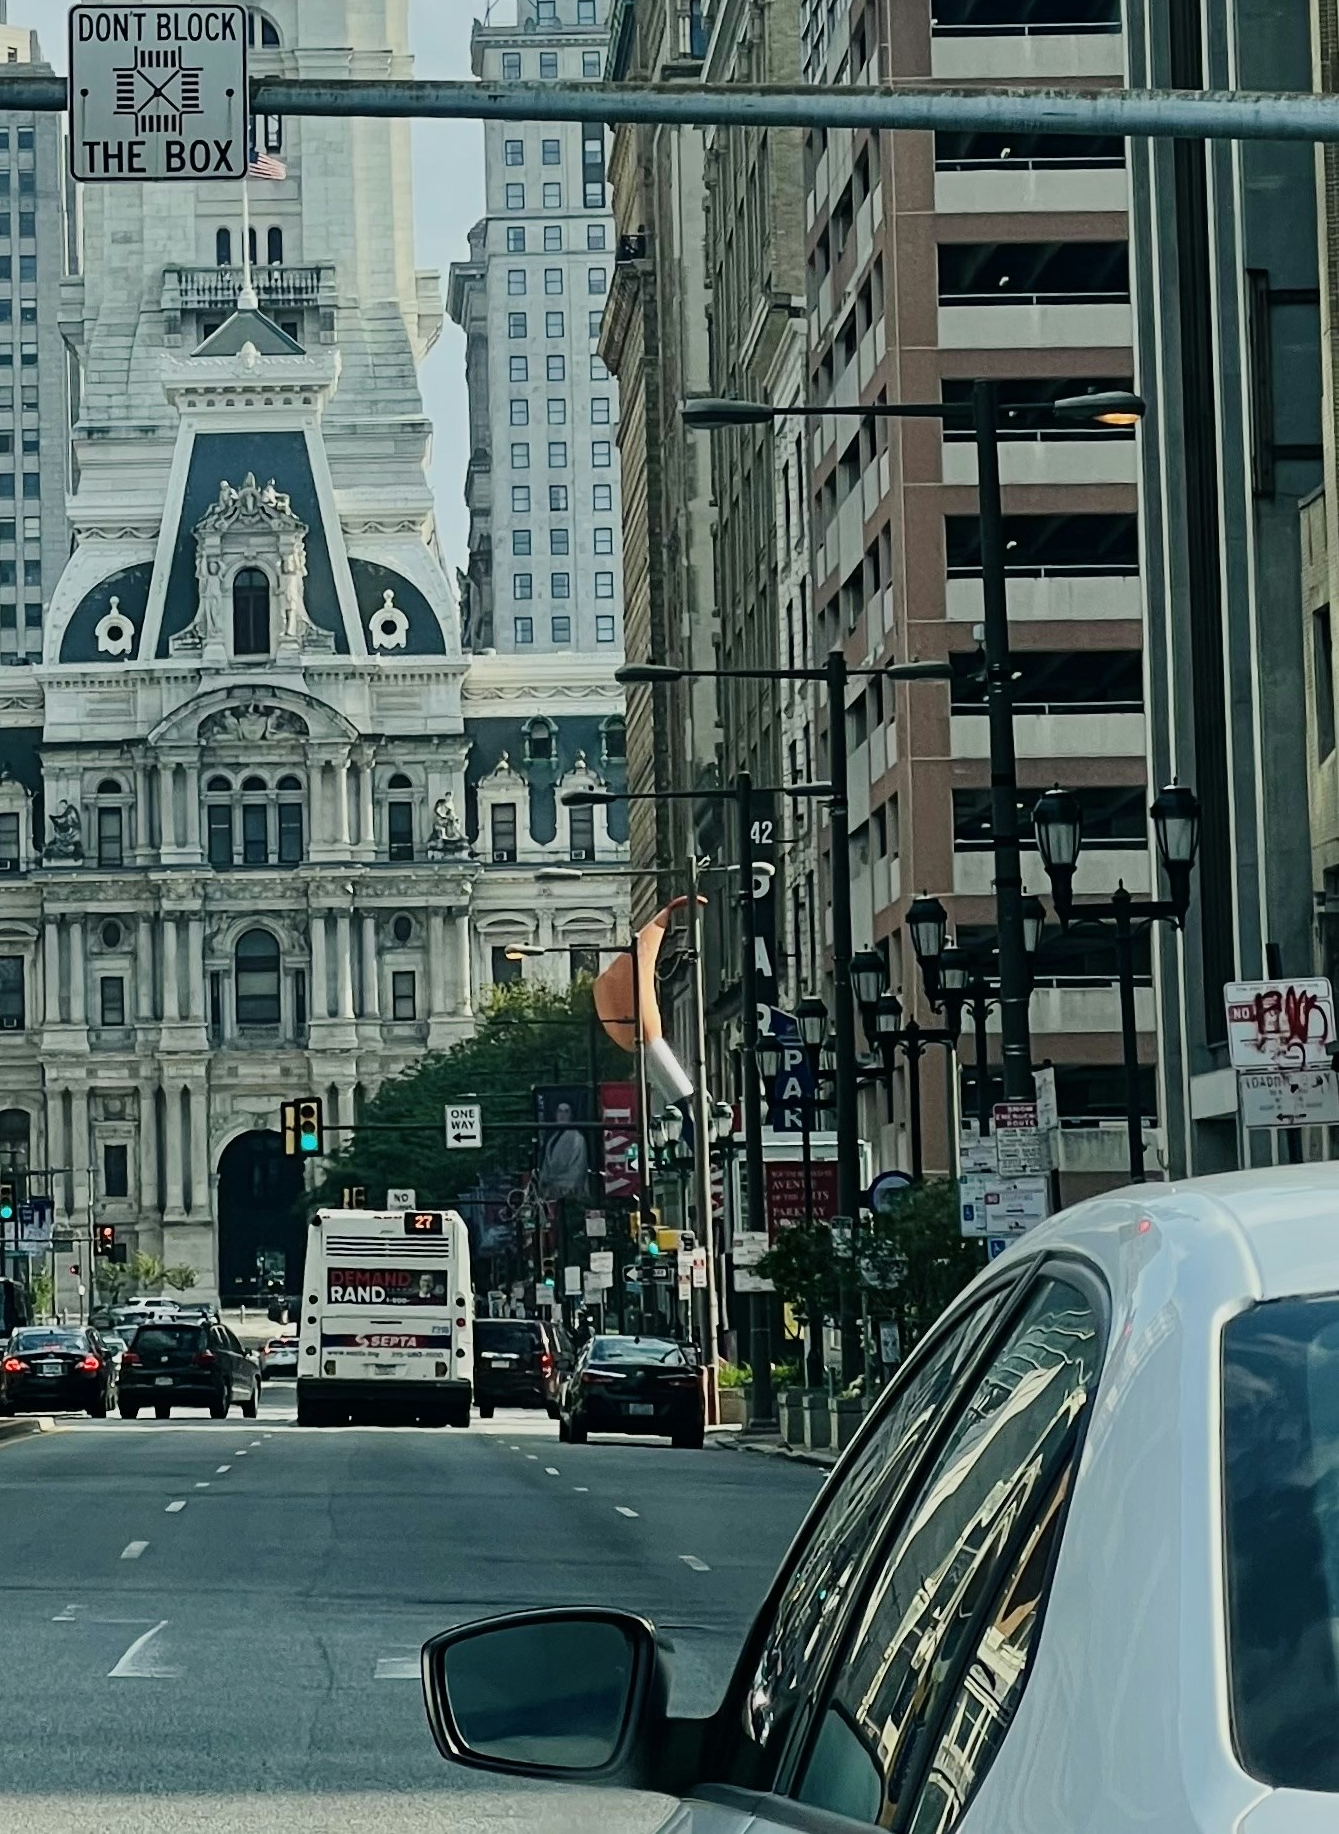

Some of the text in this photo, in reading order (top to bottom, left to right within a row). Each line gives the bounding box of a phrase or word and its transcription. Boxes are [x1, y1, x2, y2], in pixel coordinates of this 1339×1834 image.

[78, 11, 237, 42] DON'T BLOCK
[82, 139, 234, 173] THE BOX
[1233, 1007, 1250, 1019] NO
[450, 1109, 475, 1119] ONE
[450, 1120, 476, 1130] WAY
[393, 1193, 409, 1202] NO
[773, 1207, 825, 1217] PARKAY
[414, 1215, 433, 1229] 27
[330, 1270, 411, 1287] DEMAND
[330, 1286, 386, 1303] RAND
[370, 1335, 418, 1347] SEPTA
